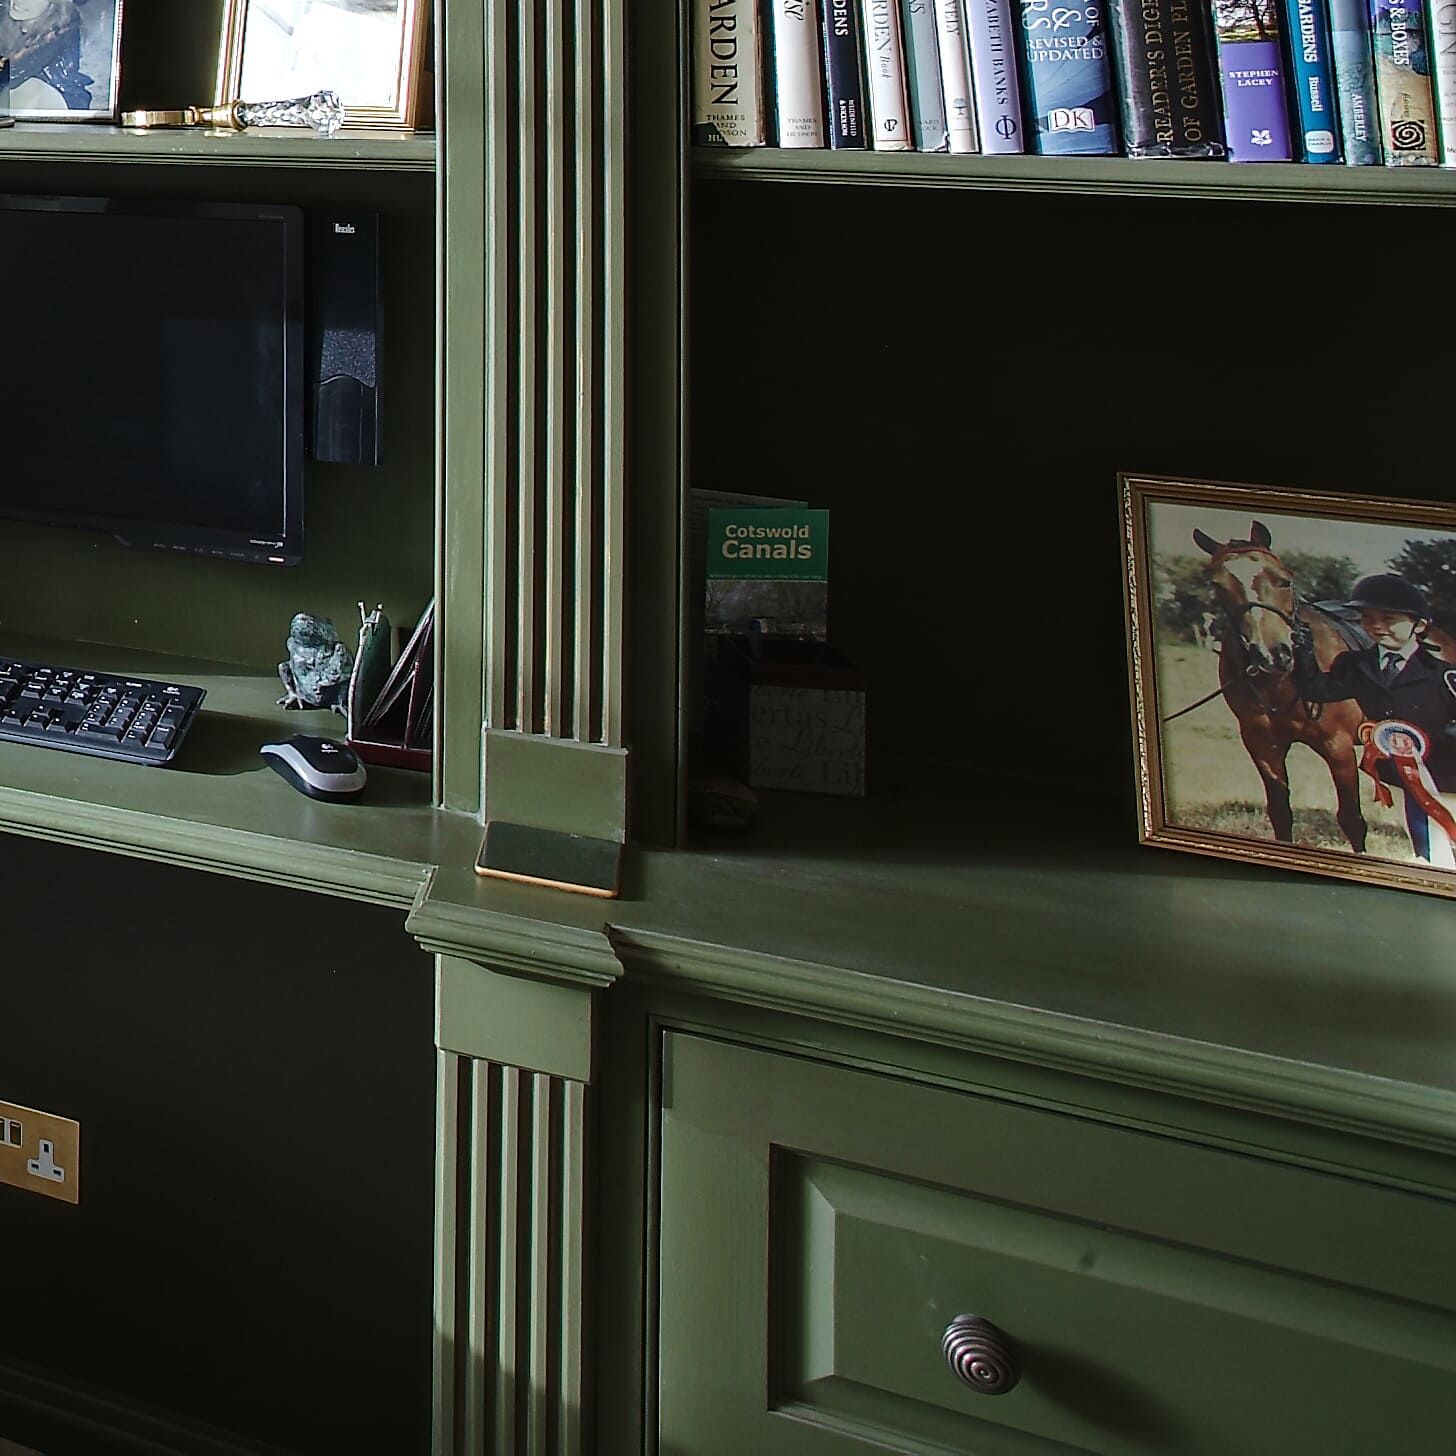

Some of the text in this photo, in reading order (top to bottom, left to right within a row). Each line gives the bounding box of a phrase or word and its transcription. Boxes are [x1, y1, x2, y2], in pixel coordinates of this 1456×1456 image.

[1051, 7, 1082, 32] &
[1086, 6, 1101, 27] OF
[1389, 6, 1404, 19] &
[1026, 35, 1088, 50] REVISED
[1391, 19, 1410, 66] BOXES
[1026, 47, 1104, 63] UPDATED
[1174, 30, 1199, 109] GARDEN
[1228, 69, 1279, 79] STEPHEN
[992, 58, 1009, 106] BANKS
[1237, 78, 1273, 87] LACEY
[1147, 51, 1175, 144] READER'S
[1308, 76, 1324, 112] Russell
[1054, 110, 1087, 128] DK
[1352, 93, 1368, 142] AMBERLEY
[1182, 116, 1202, 143] OF
[725, 524, 810, 539] Cotswold
[721, 539, 813, 560] Canals
